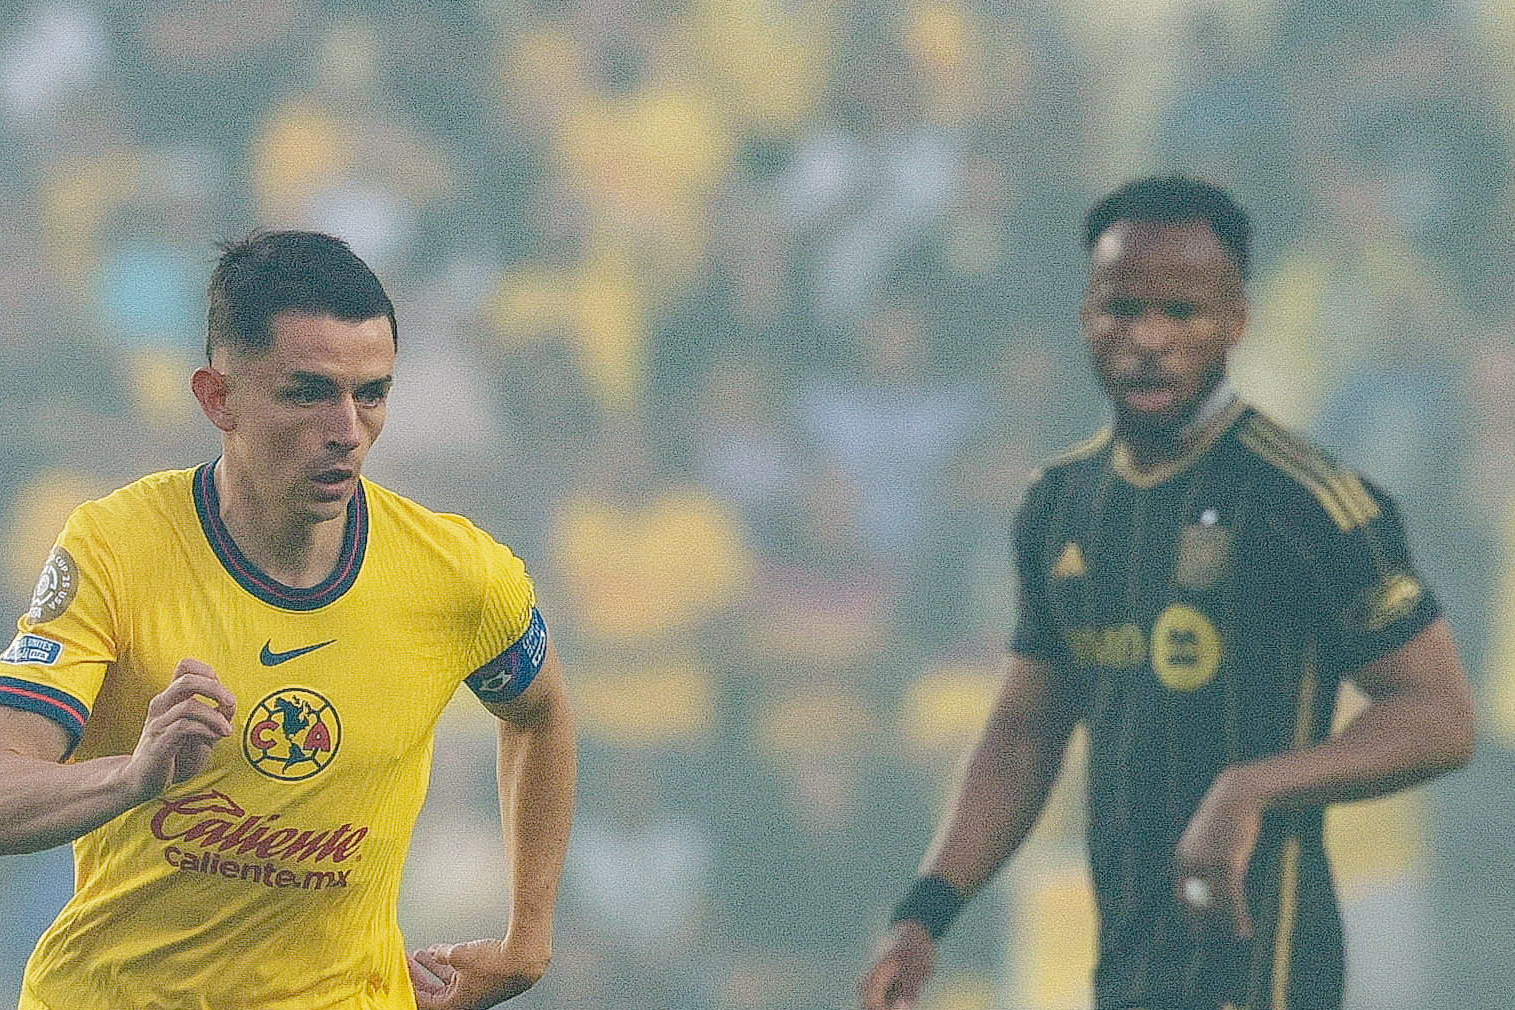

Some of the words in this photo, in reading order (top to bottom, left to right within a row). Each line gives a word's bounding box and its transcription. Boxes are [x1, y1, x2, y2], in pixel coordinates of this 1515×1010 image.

[55, 556, 69, 572] CUP
[47, 591, 67, 610] USA
[150, 789, 369, 863] Caliente
[164, 846, 352, 890] caliente.mx
